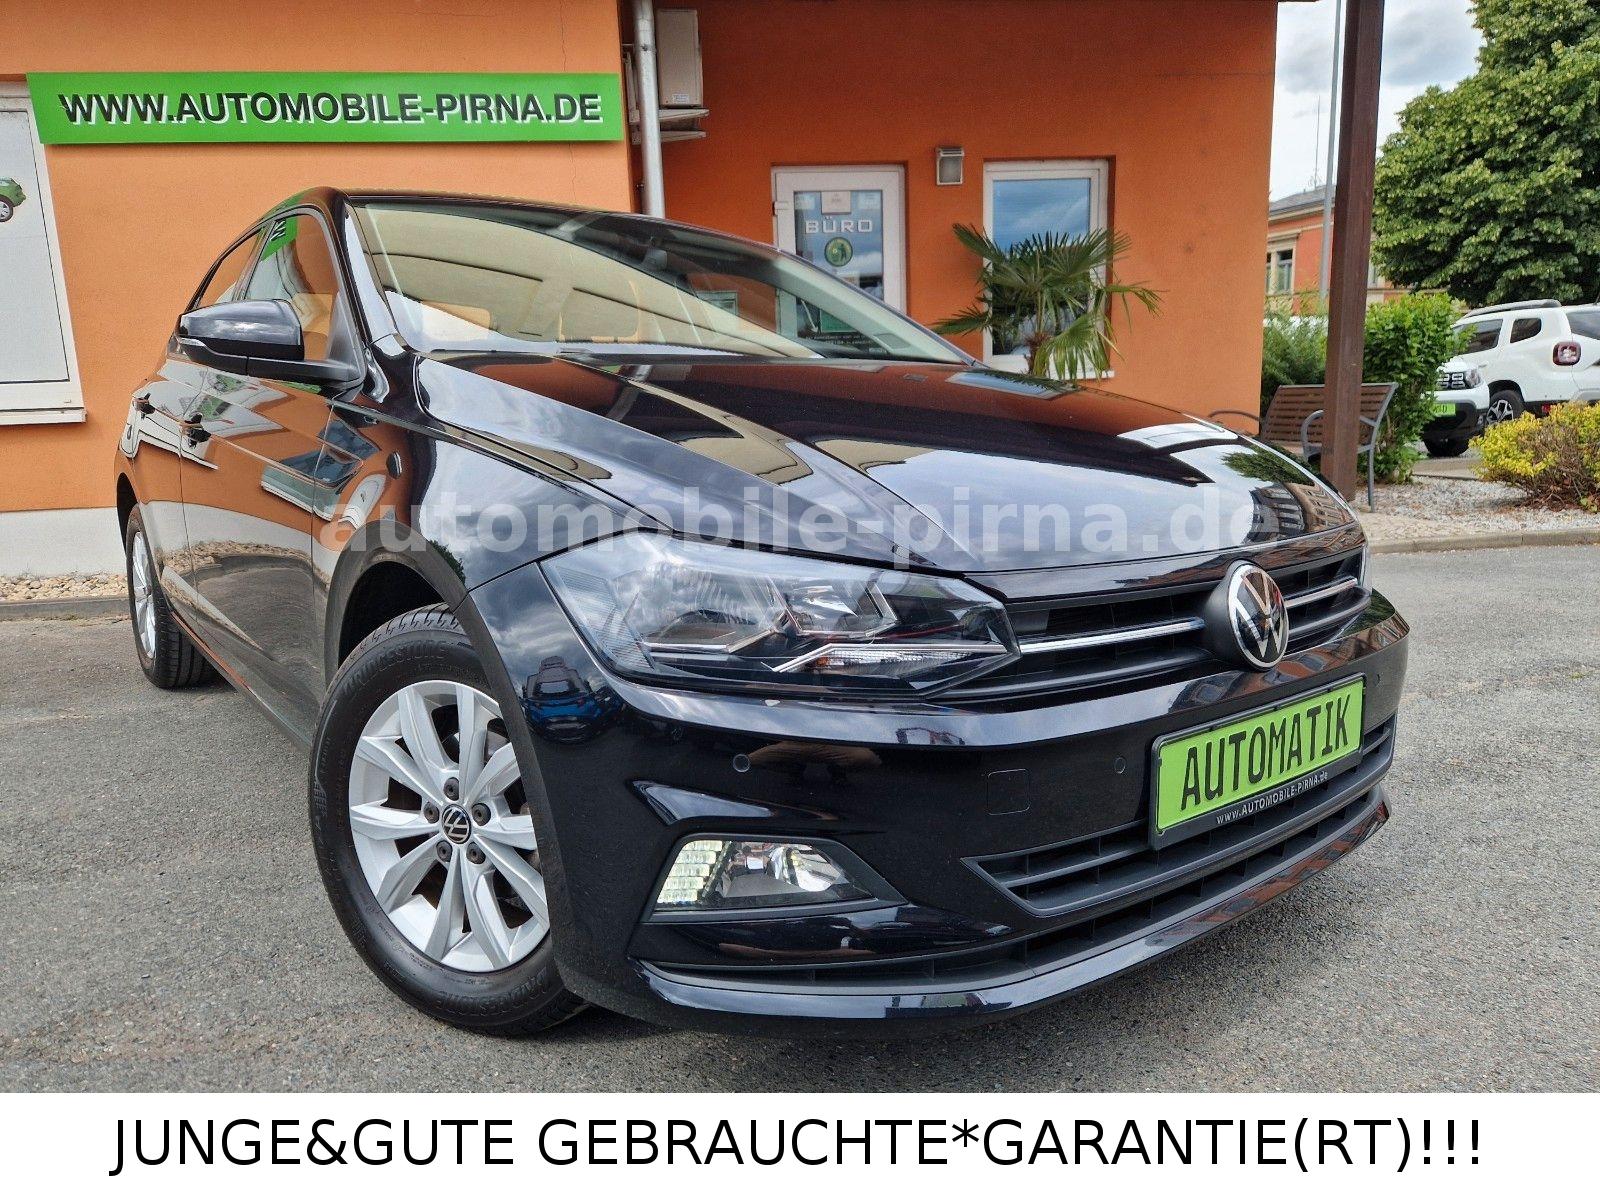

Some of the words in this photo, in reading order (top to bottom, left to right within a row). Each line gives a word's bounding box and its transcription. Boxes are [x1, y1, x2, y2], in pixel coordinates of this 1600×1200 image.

[57, 91, 604, 126] WWW.AUTOMOBILE-PIRNA.DE
[804, 215, 873, 234] BÜRO
[1180, 693, 1352, 811] AUTOMATIK
[1215, 770, 1329, 825] www.AUTOMOBILE-PIRNA.de
